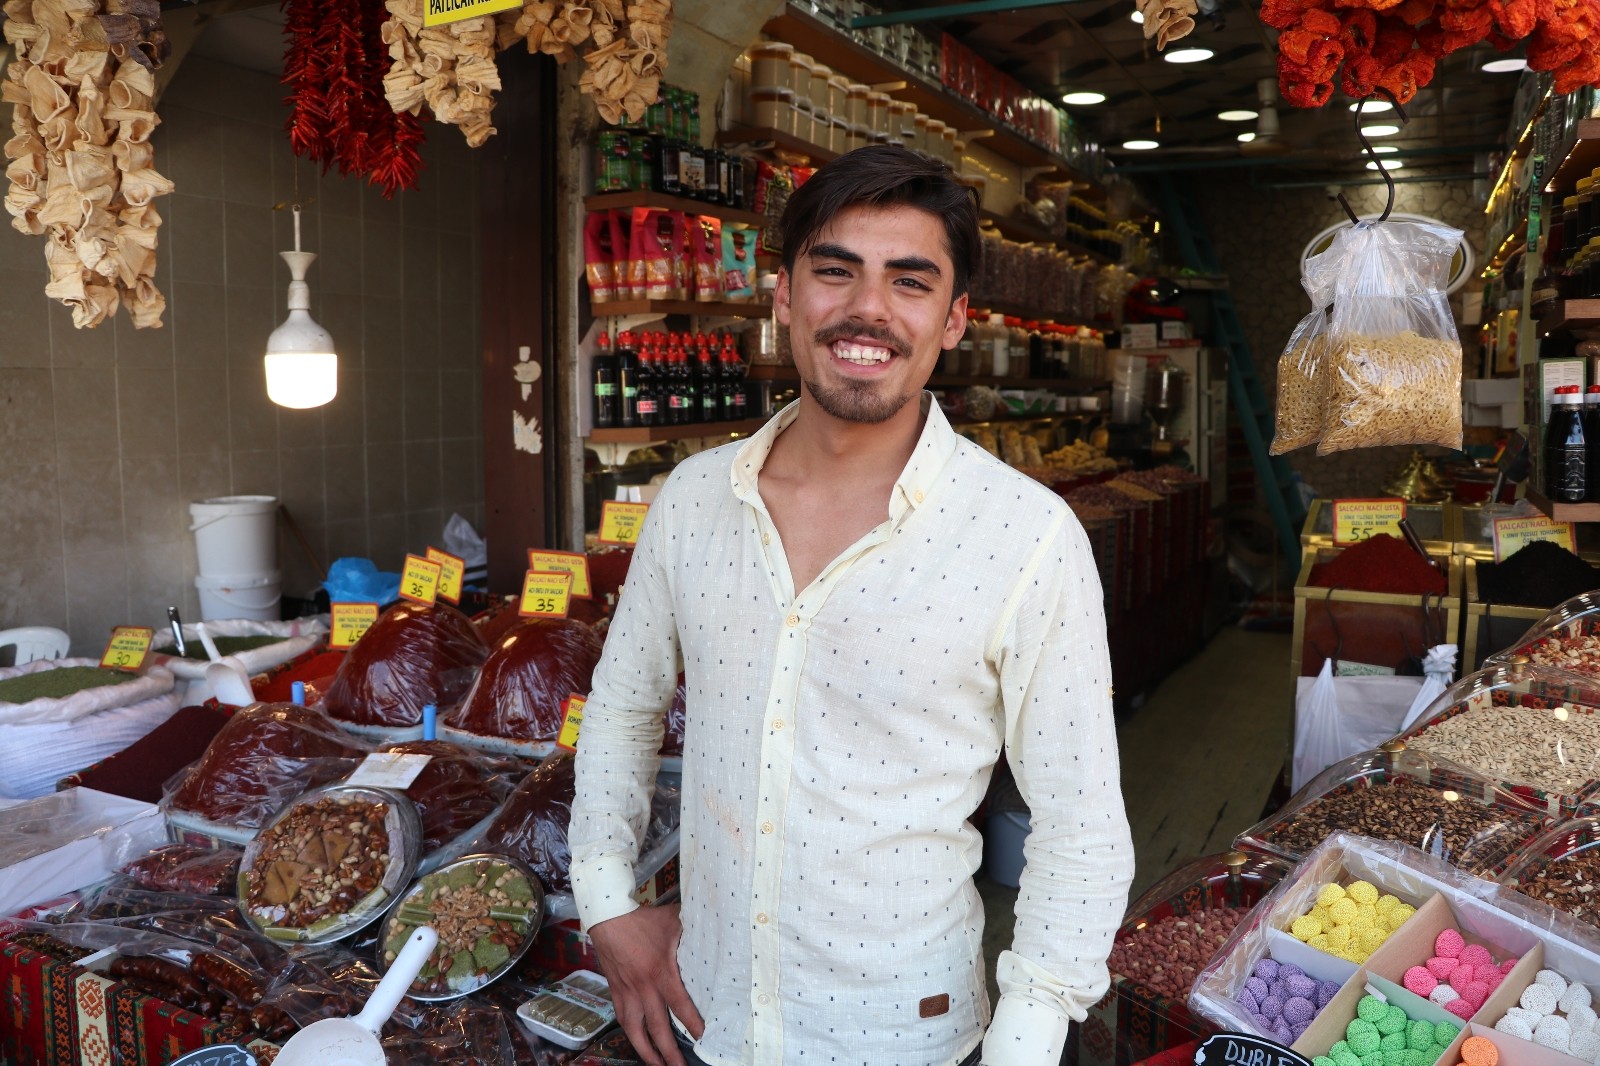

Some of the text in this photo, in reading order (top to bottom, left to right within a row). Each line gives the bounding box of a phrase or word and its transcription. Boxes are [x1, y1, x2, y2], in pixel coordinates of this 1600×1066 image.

[616, 527, 633, 541] 40
[1349, 527, 1373, 541] 55
[410, 582, 423, 598] 35
[535, 598, 555, 612] 35
[112, 651, 130, 666] 30
